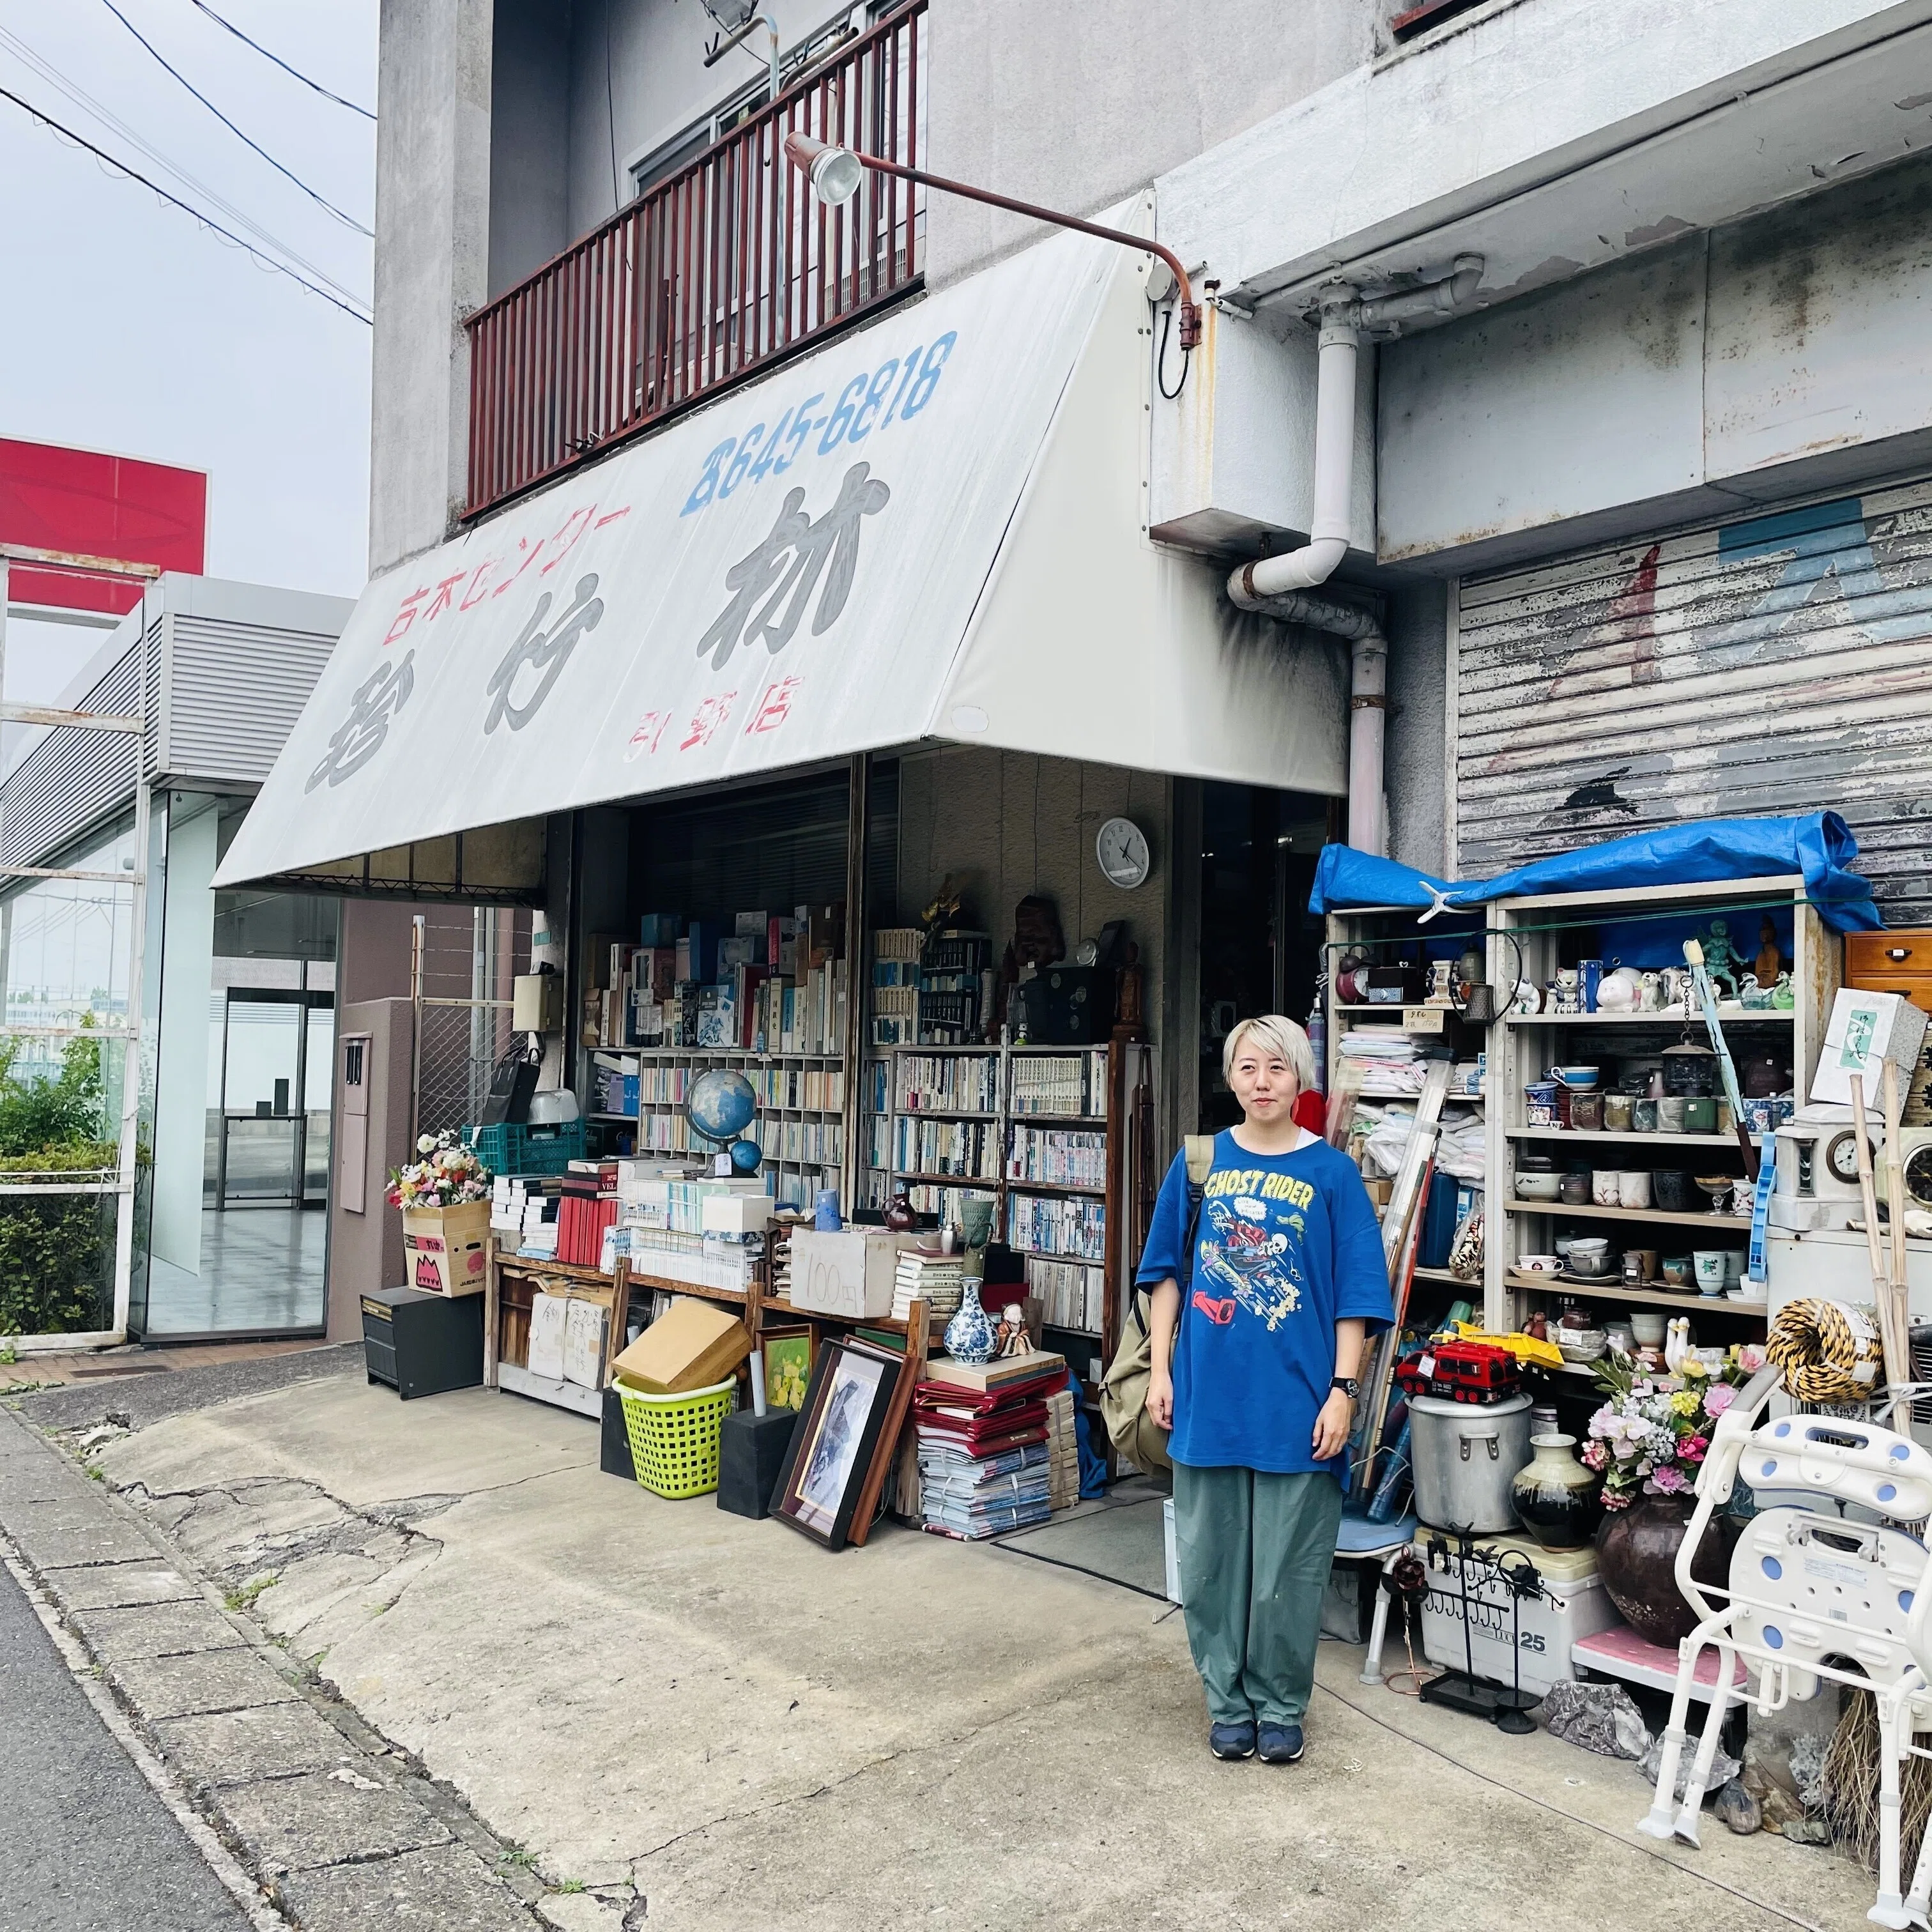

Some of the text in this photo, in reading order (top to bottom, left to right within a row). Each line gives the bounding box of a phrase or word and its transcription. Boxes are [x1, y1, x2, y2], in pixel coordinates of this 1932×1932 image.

[717, 330, 958, 500] 645-6818
[602, 1183, 617, 1191] VEL
[1204, 1169, 1315, 1213] GHOST RIDER
[806, 1252, 858, 1314] 100円
[1520, 1631, 1545, 1652] 25
